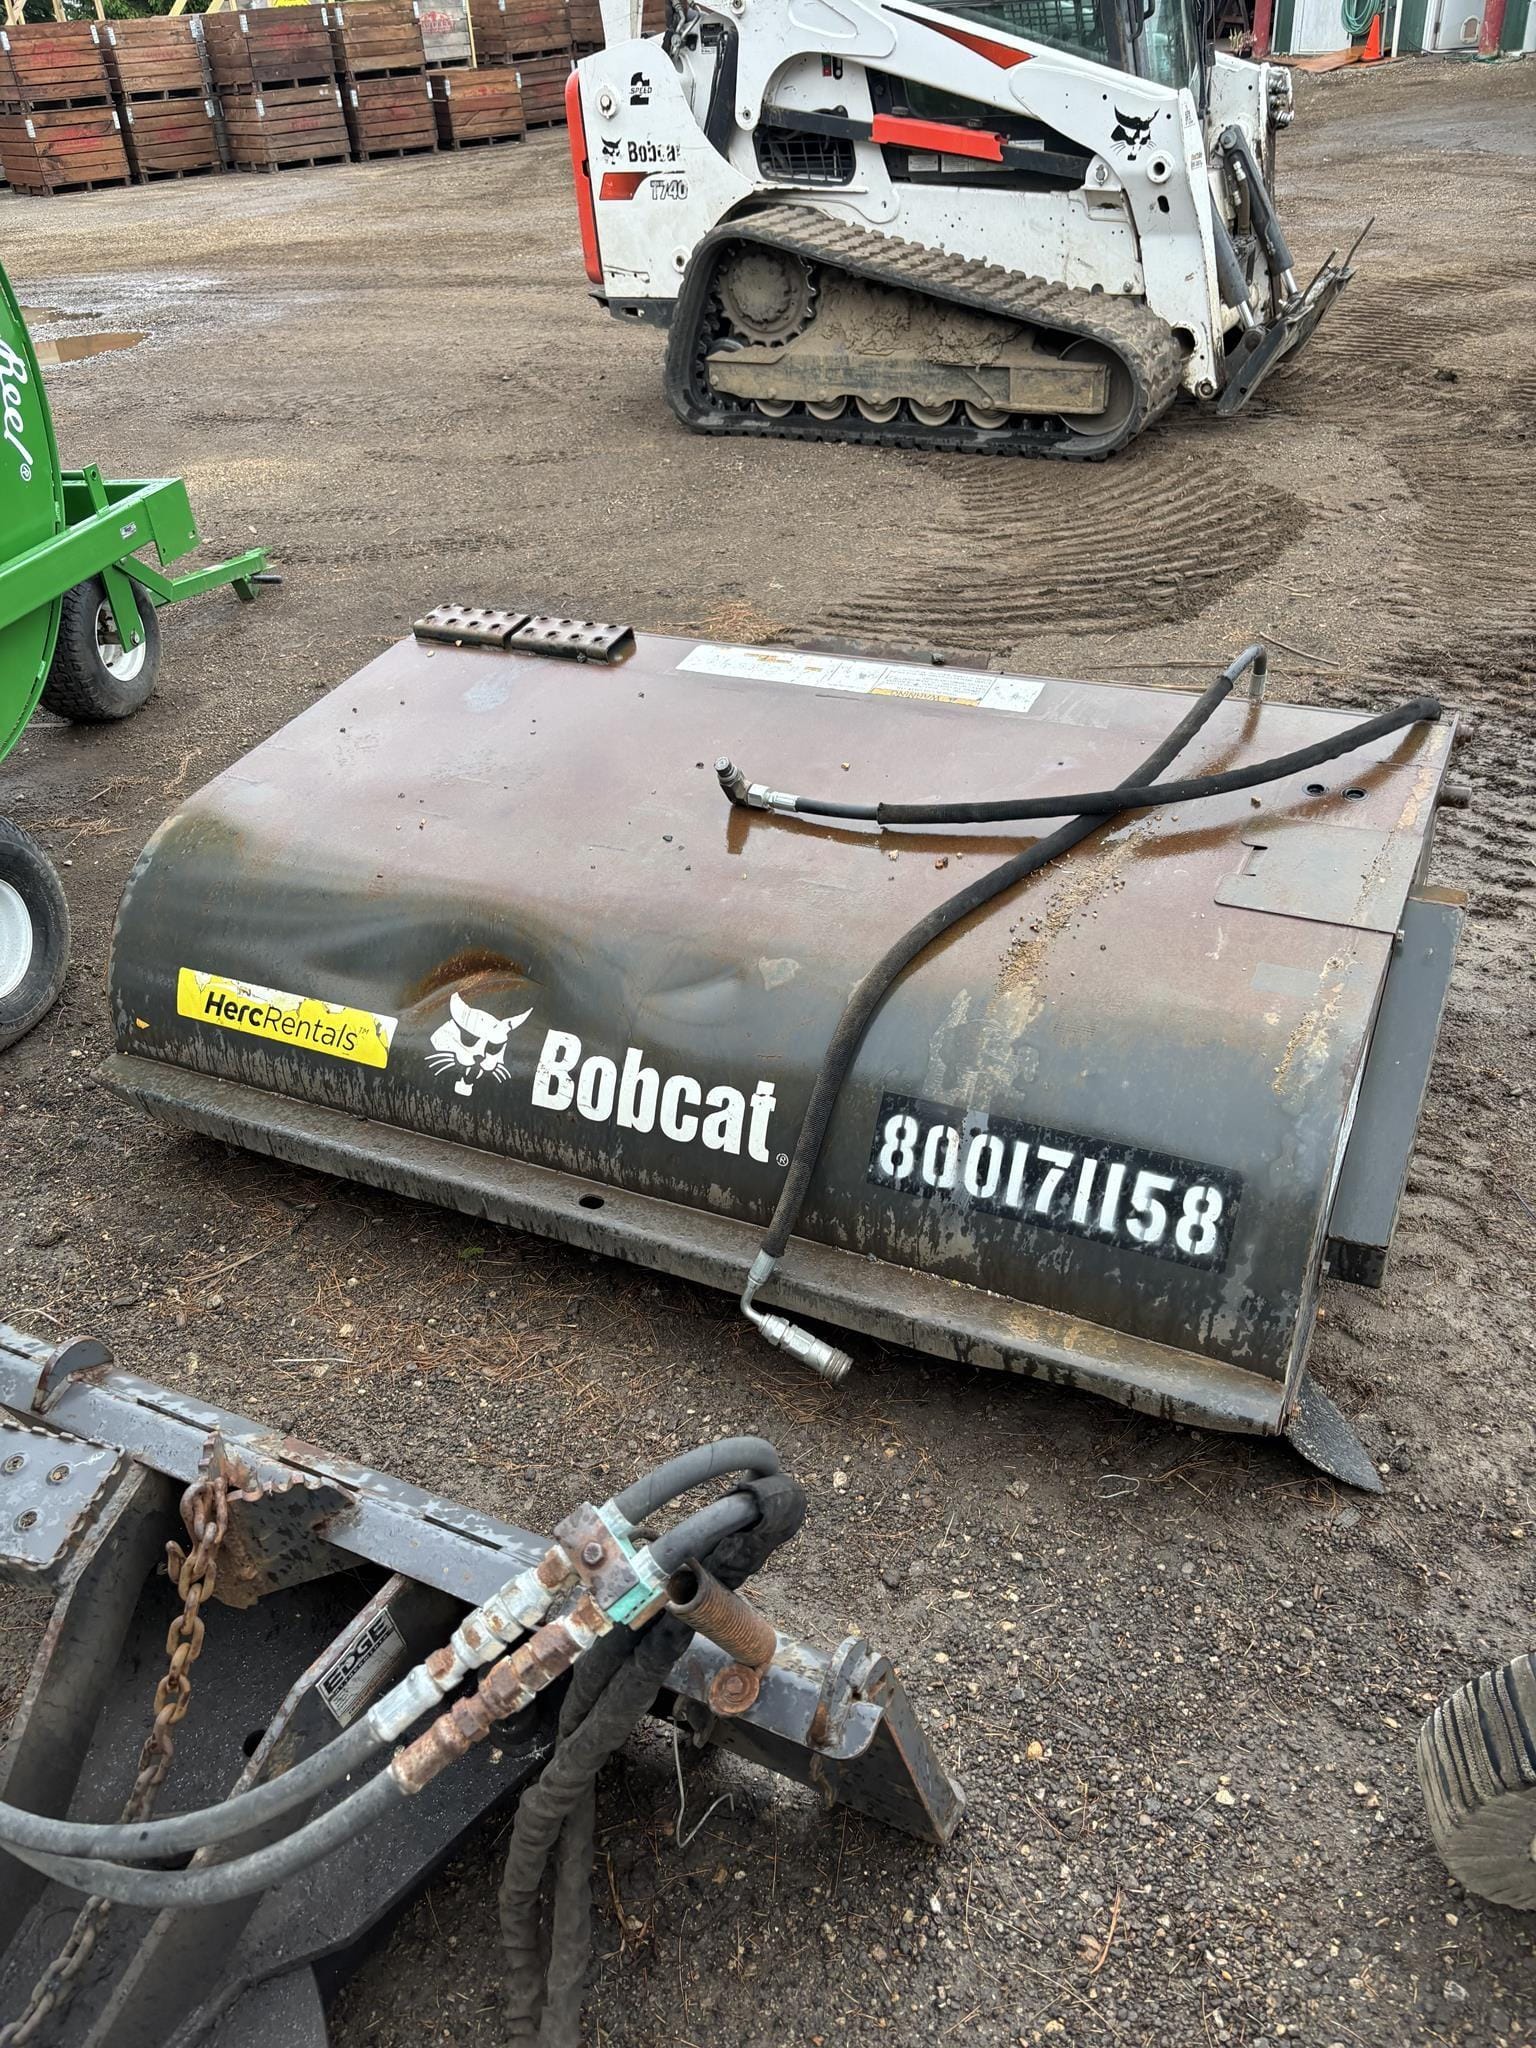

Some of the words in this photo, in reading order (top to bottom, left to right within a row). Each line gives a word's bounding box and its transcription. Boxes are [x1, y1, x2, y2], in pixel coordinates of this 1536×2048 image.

[629, 87, 653, 95] SPEED
[650, 179, 689, 201] T740
[879, 1113, 1223, 1255] 800171158
[322, 1616, 389, 1695] EDGE
